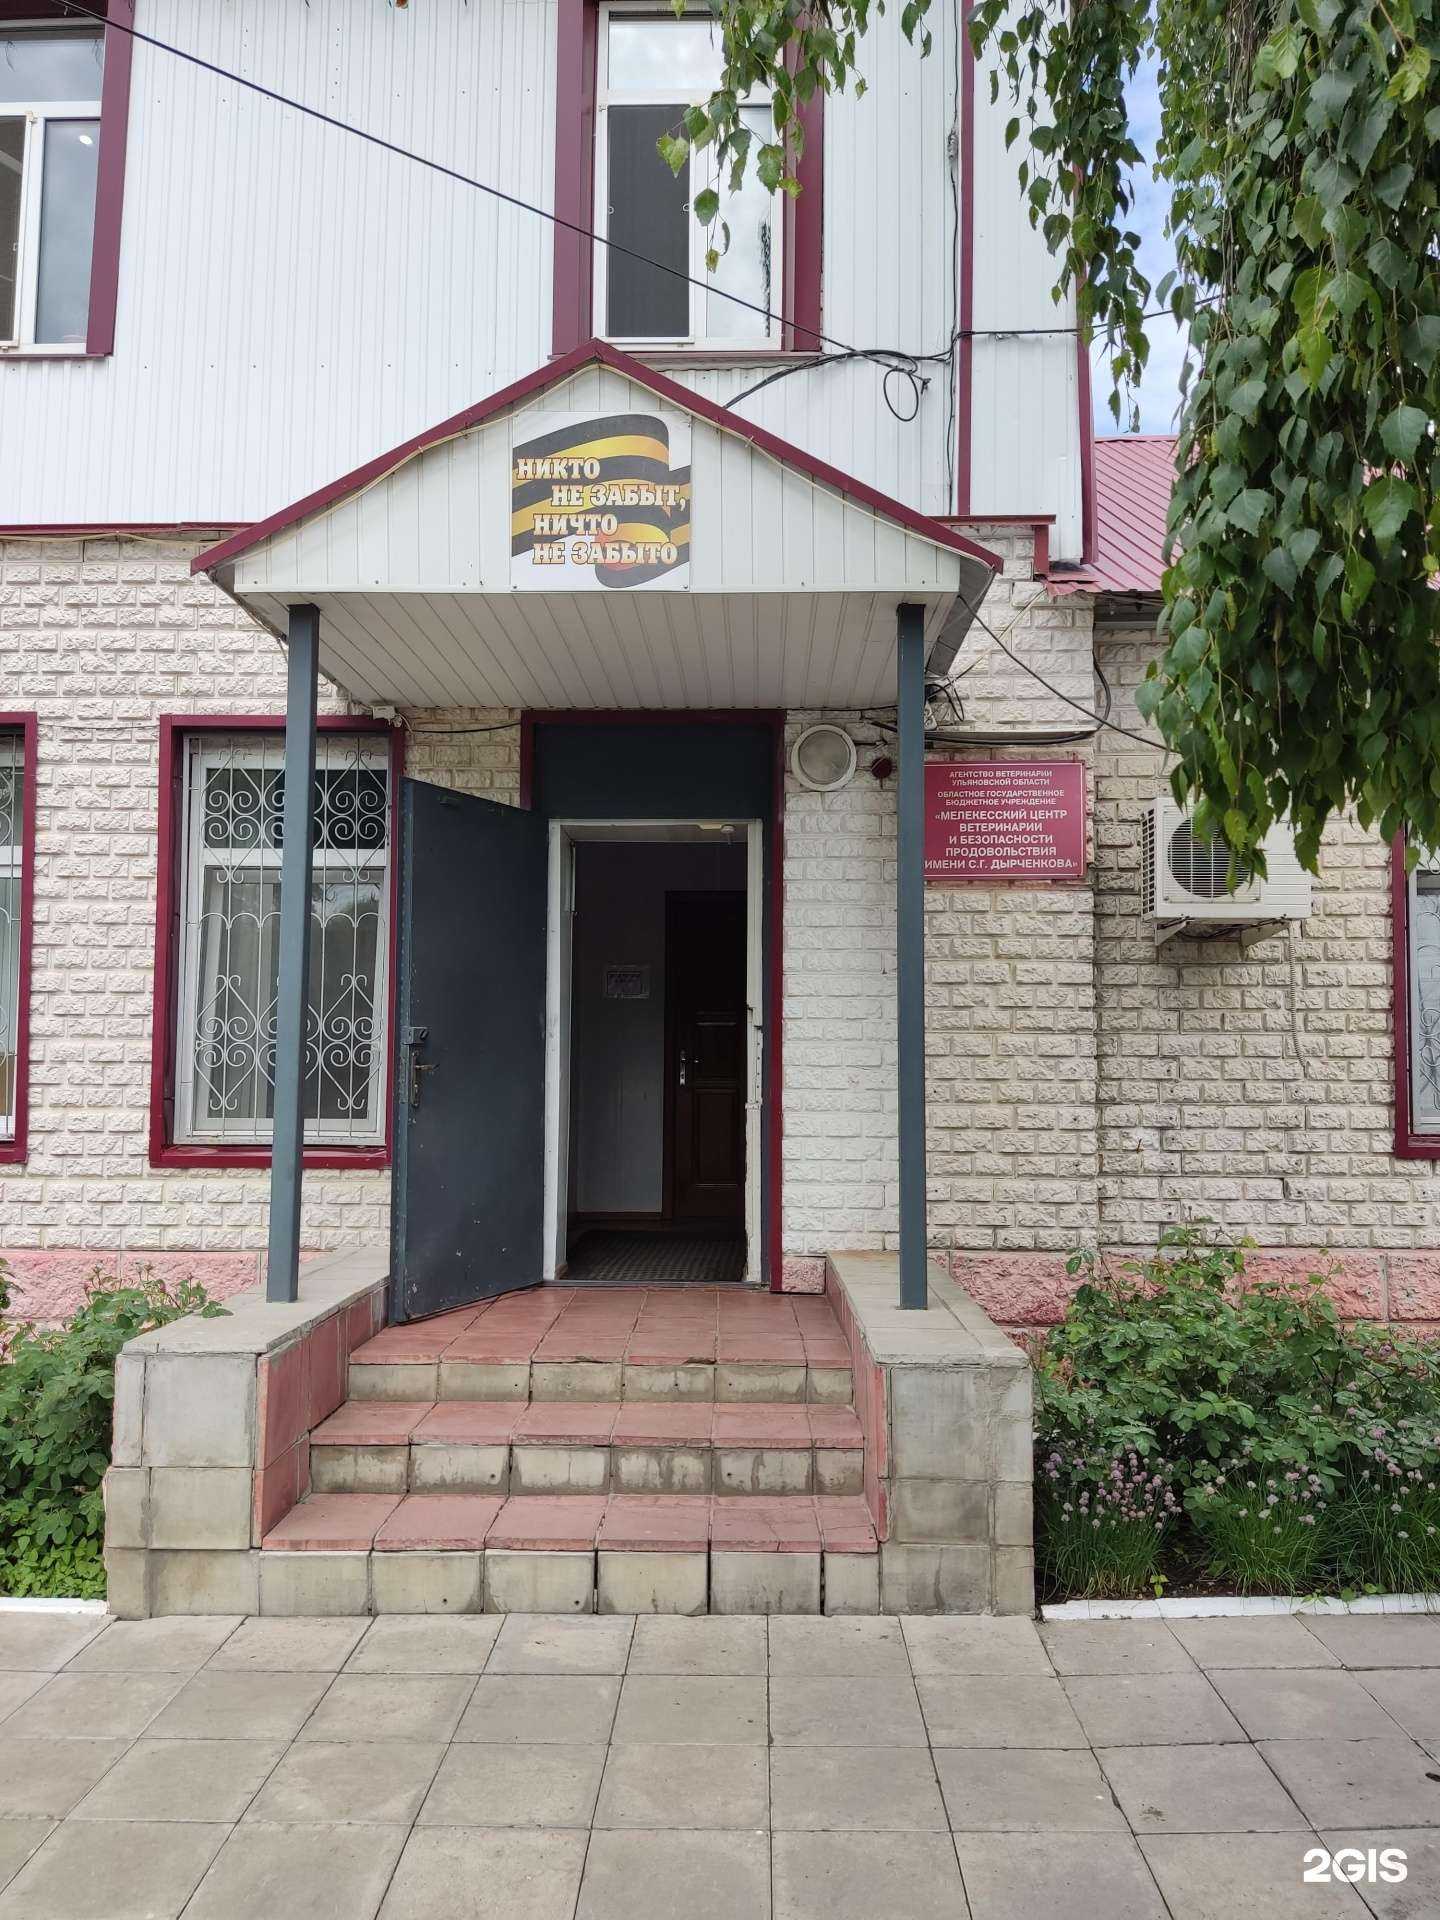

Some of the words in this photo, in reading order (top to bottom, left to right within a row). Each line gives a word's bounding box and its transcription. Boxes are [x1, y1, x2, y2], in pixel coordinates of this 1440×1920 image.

[516, 456, 601, 481] НИКТО
[550, 484, 584, 507] НЕ
[590, 484, 686, 512] ЗАБЫТ,
[532, 513, 618, 536] НИЧТО
[532, 542, 566, 565] НЕ
[571, 541, 679, 566] ЗАБЫТО
[952, 778, 1012, 786] УЛЬЯНОВСКОЙ
[1012, 778, 1050, 786] ОБЛАСТИ
[937, 790, 986, 798] ОБЛАСТНОЕ
[986, 789, 1065, 798] ГОСУДАРСТВЕННОЕ
[945, 798, 1000, 807] БЮДЖЕТНОЕ
[1000, 798, 1057, 806] УЧРЕЖДЕНИЕ
[935, 809, 1027, 821] «МЕЛЕКЕССКИЙ
[1029, 809, 1068, 821] ЦЕНТР
[959, 822, 1043, 832] ВЕТЕРИНАРИИ
[949, 835, 958, 845] И
[960, 834, 1054, 845] БЕЗОПАСНОСТИ
[945, 846, 1057, 858] ПРОДОВОЛЬСТВИЯ
[924, 860, 966, 869] ИМЕНИ
[968, 860, 988, 869] С.Г.
[990, 858, 1079, 870] ДЫРЧЕНКОВА»
